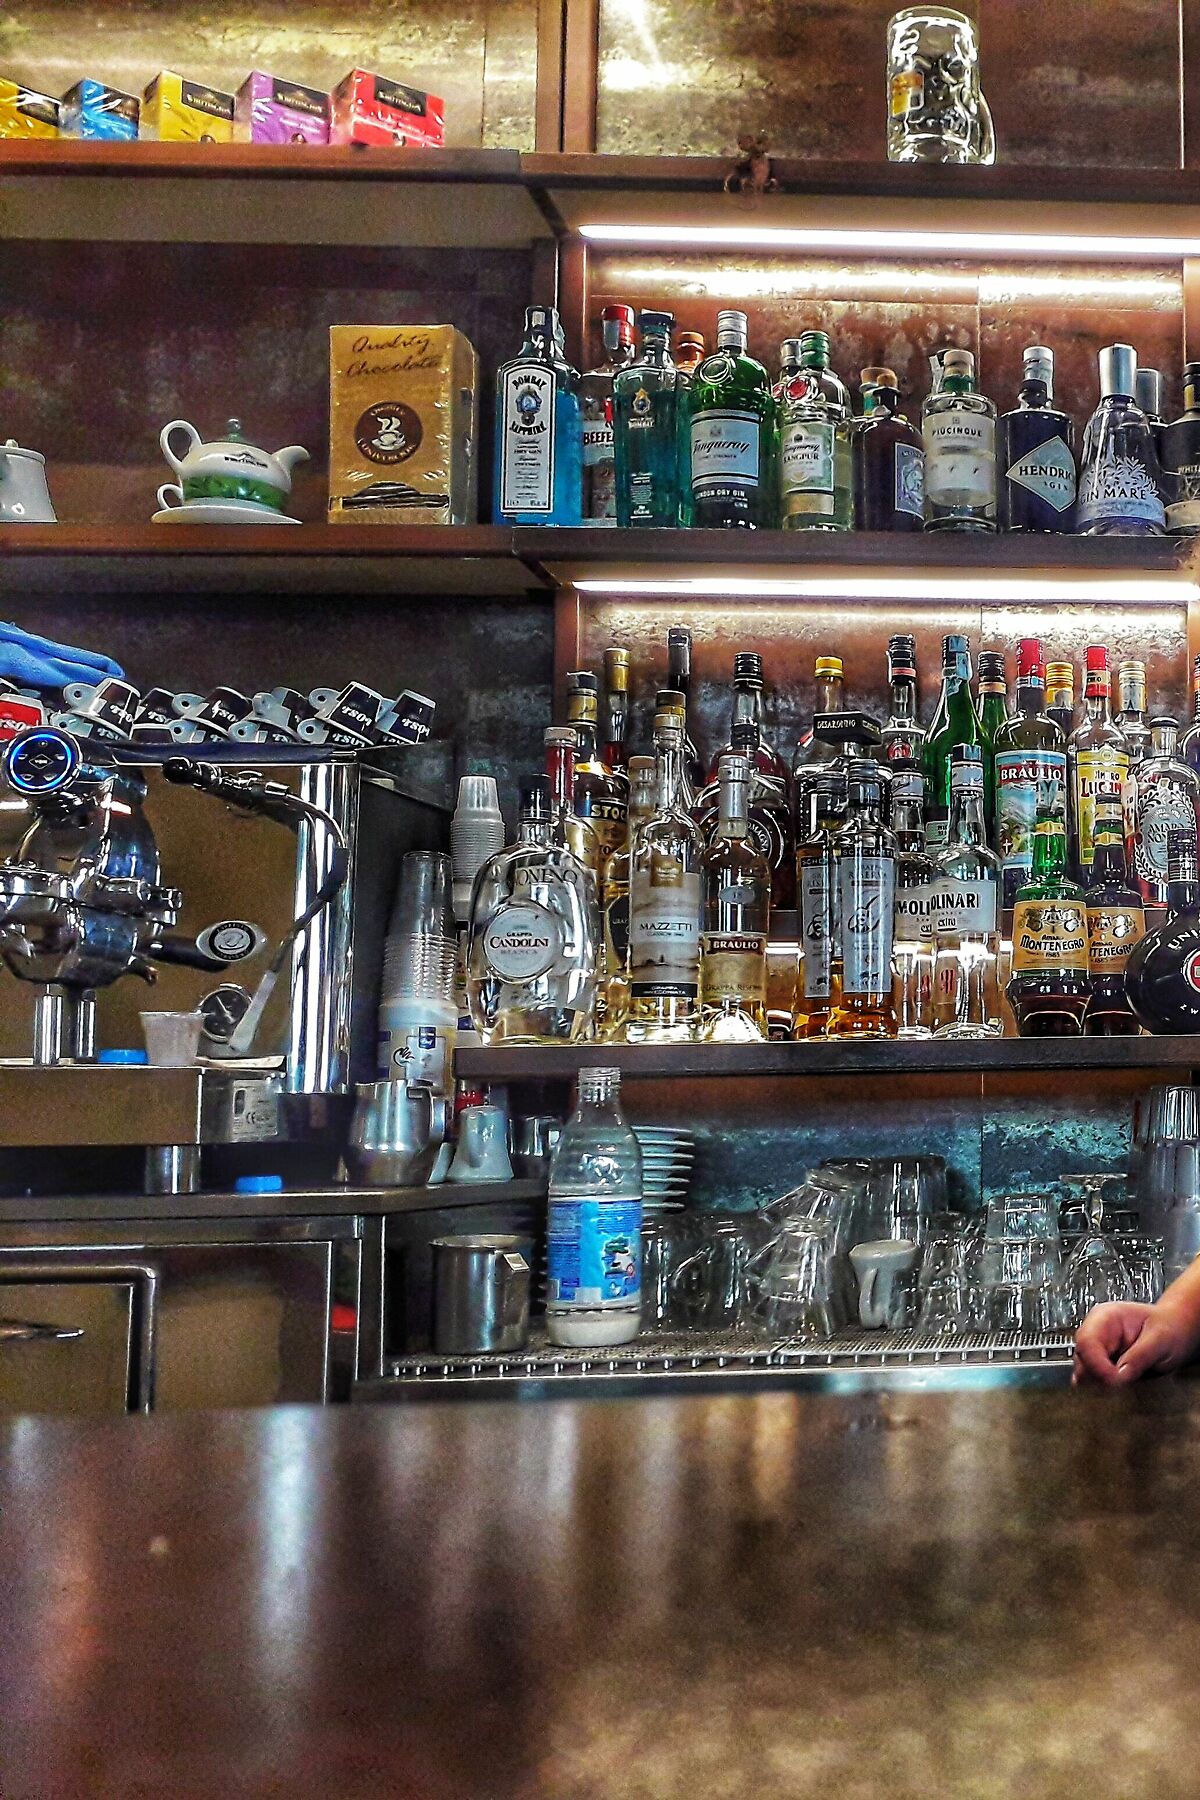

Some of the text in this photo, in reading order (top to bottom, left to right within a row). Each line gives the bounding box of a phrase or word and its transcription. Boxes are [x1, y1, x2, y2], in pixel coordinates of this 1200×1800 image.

[511, 374, 548, 391] BOMBAY
[508, 420, 548, 436] SAPPHIRE
[692, 439, 750, 454] Tanqueray
[1080, 487, 1147, 504] GIN MARE
[1000, 766, 1063, 781] BRAULIO
[639, 922, 693, 933] MAZZETTI
[488, 935, 550, 949] CANDOLINI
[712, 940, 759, 950] BRAULIO
[1020, 934, 1085, 952] MONTENEGRO
